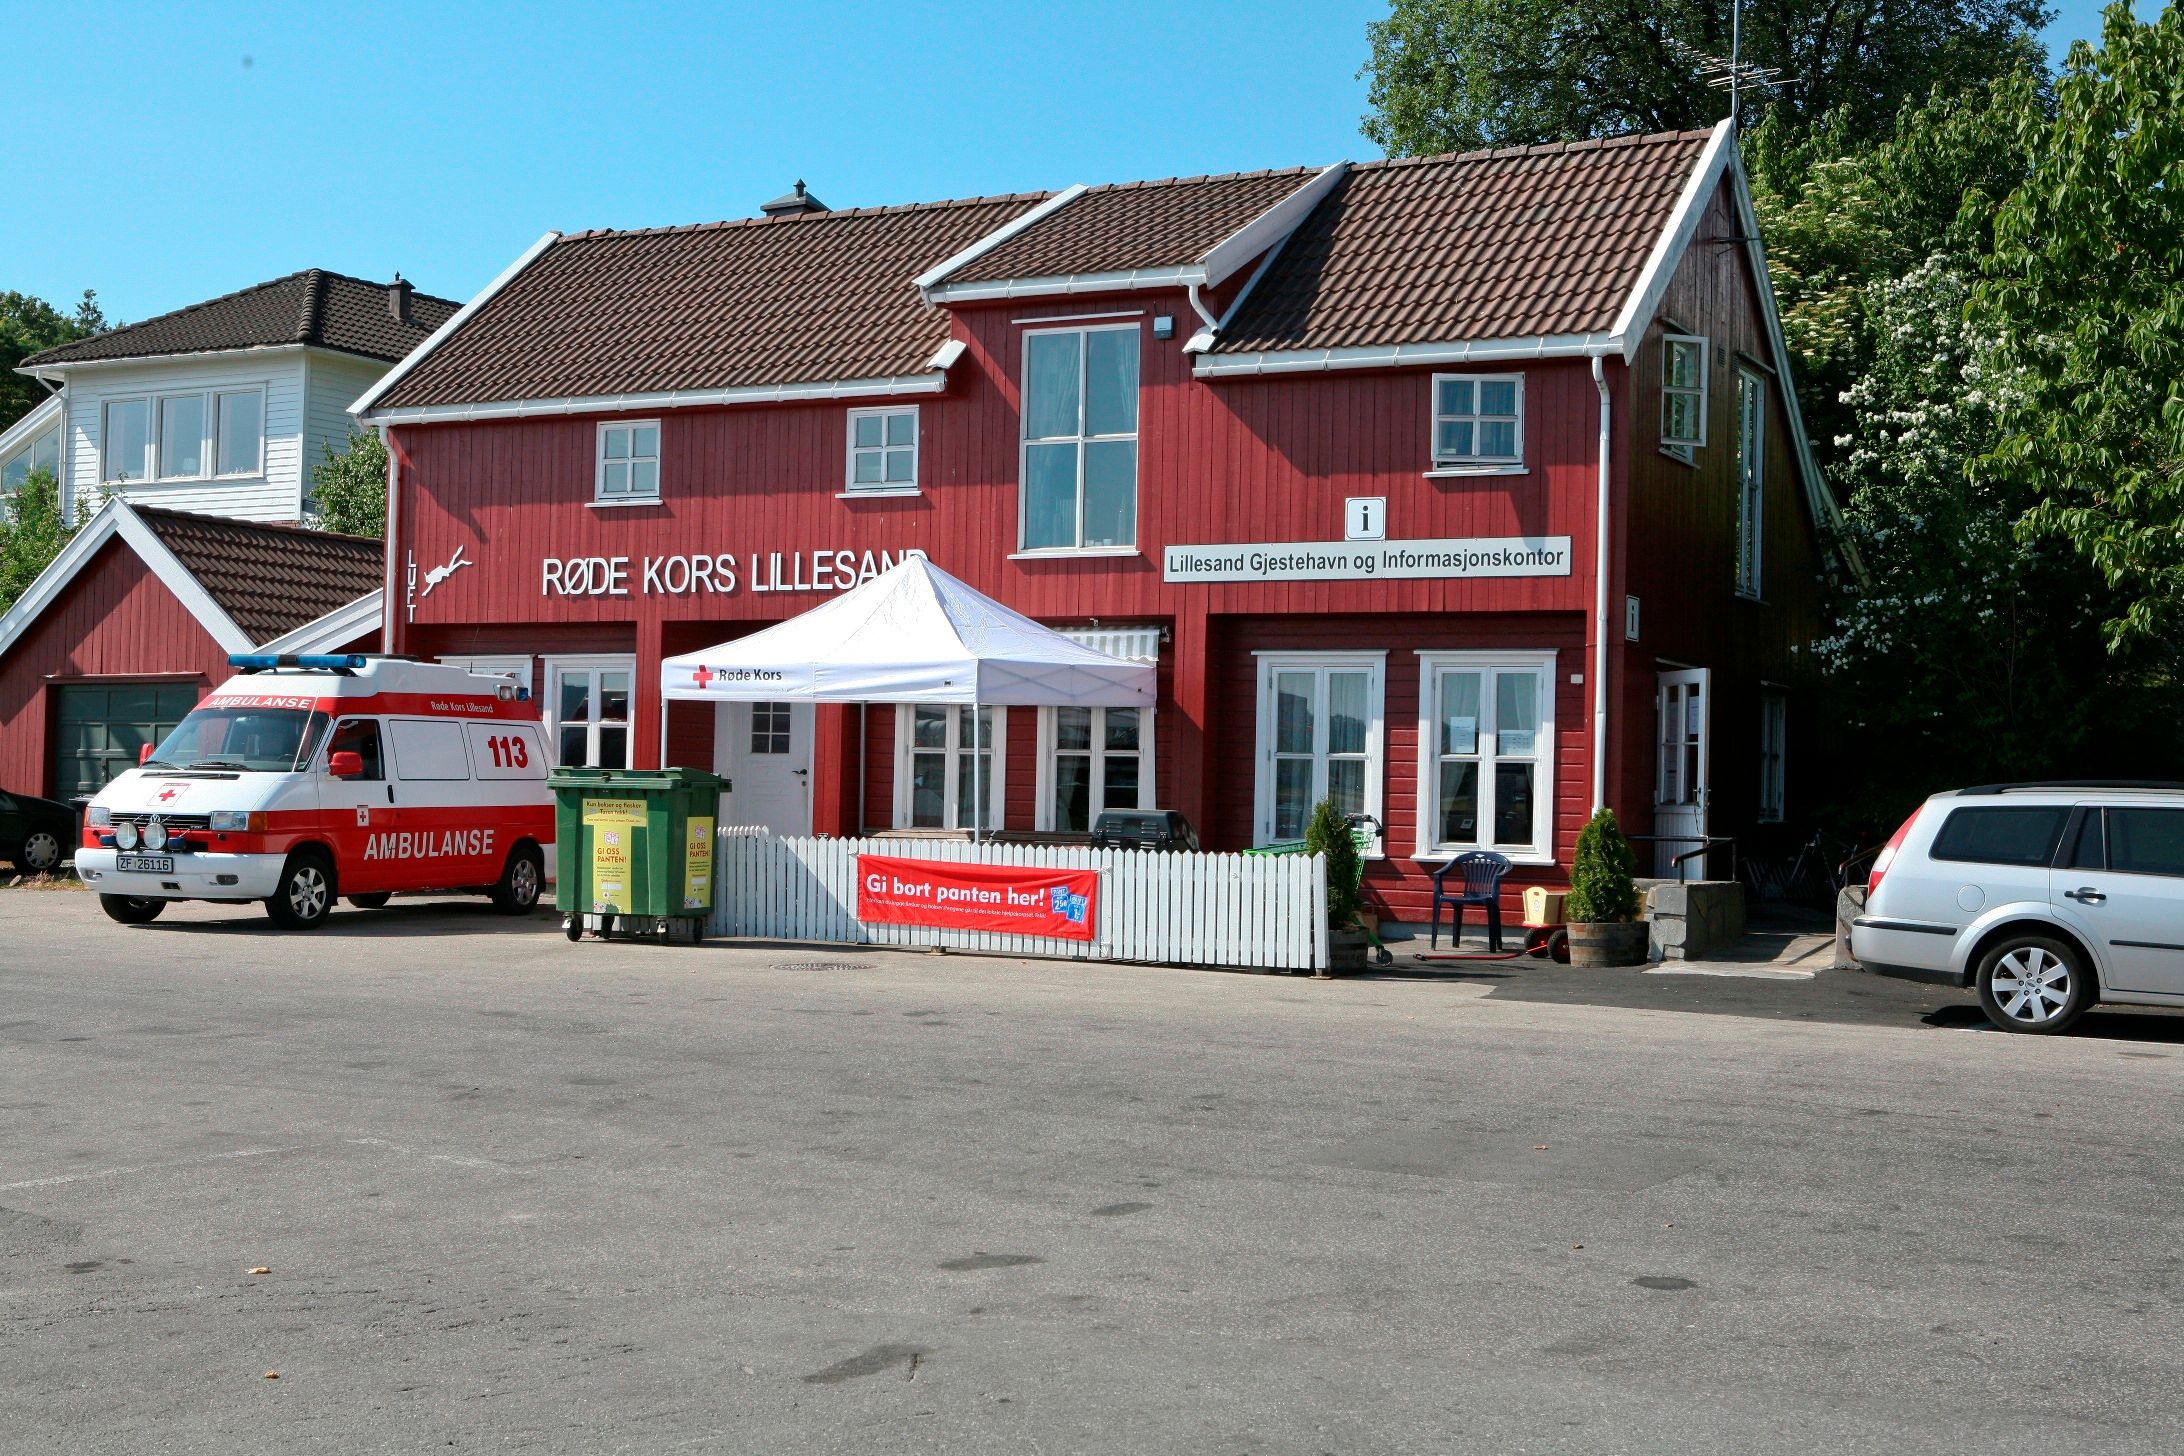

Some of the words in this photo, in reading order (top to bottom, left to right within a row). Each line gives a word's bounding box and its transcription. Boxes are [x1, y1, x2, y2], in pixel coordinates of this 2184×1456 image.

[542, 556, 628, 596] RØDE
[644, 554, 736, 594] KORS
[1170, 554, 1244, 572] Lillesand
[1250, 552, 1347, 575] Gjestehavn
[1354, 556, 1374, 574] og
[1383, 548, 1564, 572] Informasjonskontor
[407, 550, 416, 622] LUFT
[720, 669, 750, 680] Røde
[754, 669, 782, 680] Kors
[208, 696, 312, 708] AMBULANSE
[450, 702, 465, 712] Kors
[466, 702, 493, 713] Lillesand
[488, 736, 528, 768] 113
[364, 829, 494, 860] AMBULANSE
[120, 858, 132, 868] ZF
[138, 860, 168, 870] 26116
[866, 874, 887, 892] Gi
[894, 876, 931, 897] bort
[937, 886, 1000, 904] panten
[1008, 886, 1044, 906] her!
